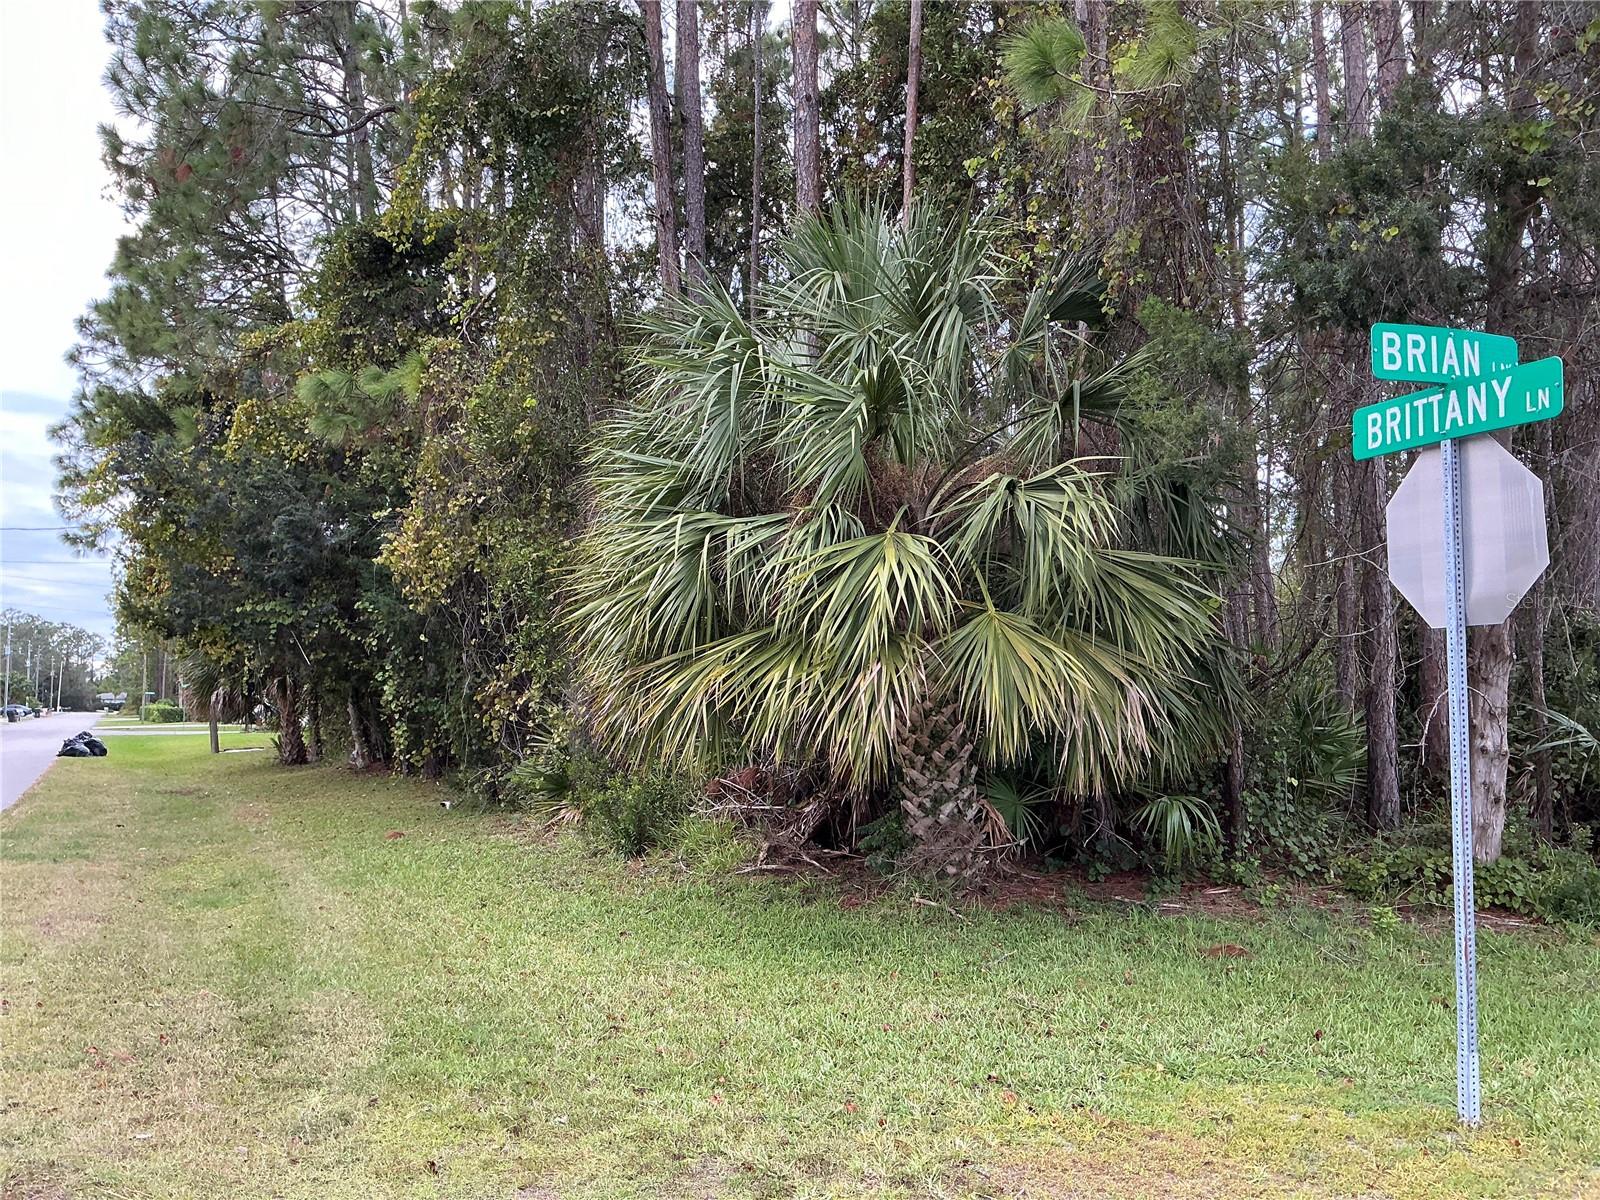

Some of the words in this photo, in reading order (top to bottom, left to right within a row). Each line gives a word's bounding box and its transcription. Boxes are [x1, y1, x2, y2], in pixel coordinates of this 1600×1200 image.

[1382, 331, 1480, 377] BRIAN
[1367, 376, 1512, 450] BRITTANY
[1526, 387, 1550, 413] LN
